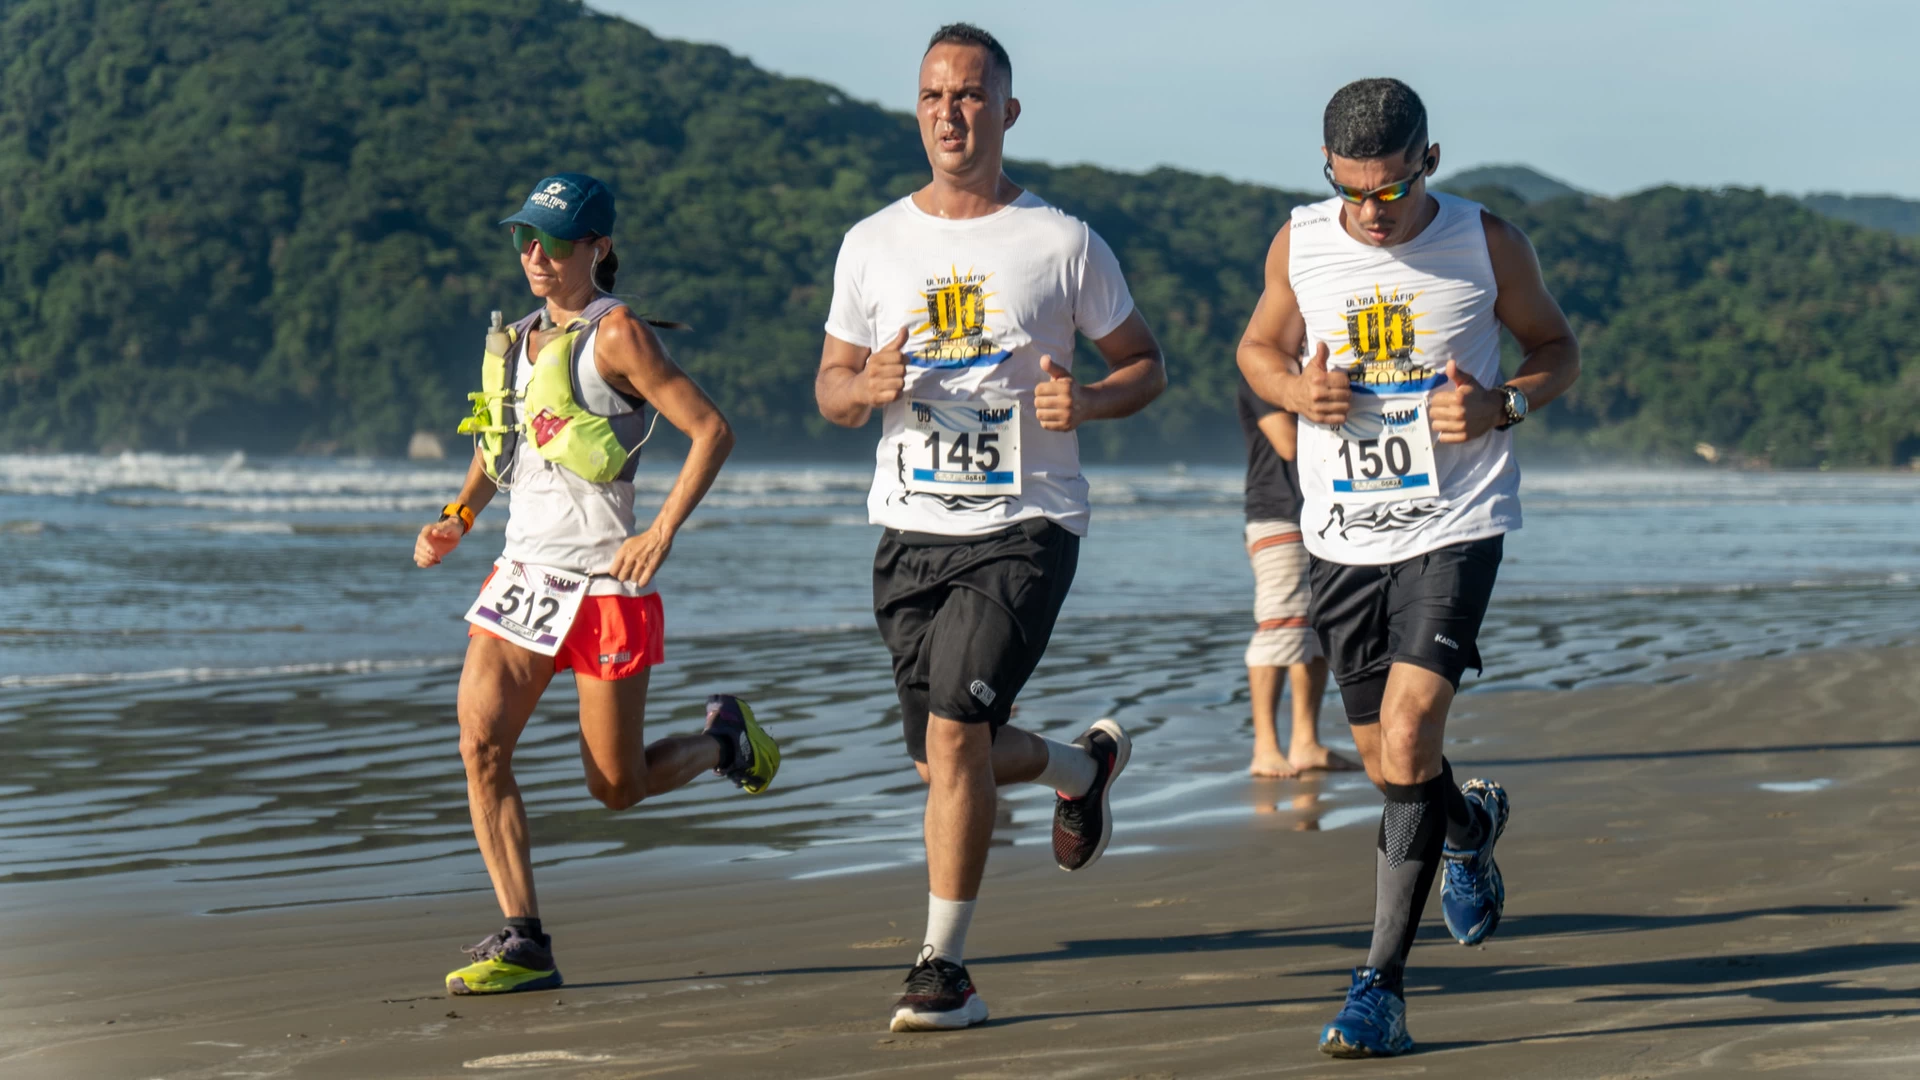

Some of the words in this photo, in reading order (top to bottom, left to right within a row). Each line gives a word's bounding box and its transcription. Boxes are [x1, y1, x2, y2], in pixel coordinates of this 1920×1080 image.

[549, 196, 568, 210] TIPS
[926, 277, 952, 287] ULTRA
[953, 274, 986, 284] DESAFIO
[1346, 296, 1375, 307] ULTRA
[1378, 293, 1415, 304] DESAFIO
[978, 408, 1010, 423] 15KM
[1381, 409, 1416, 425] 15KM
[924, 431, 1000, 472] 145
[1338, 436, 1412, 479] 150
[495, 584, 560, 634] 512
